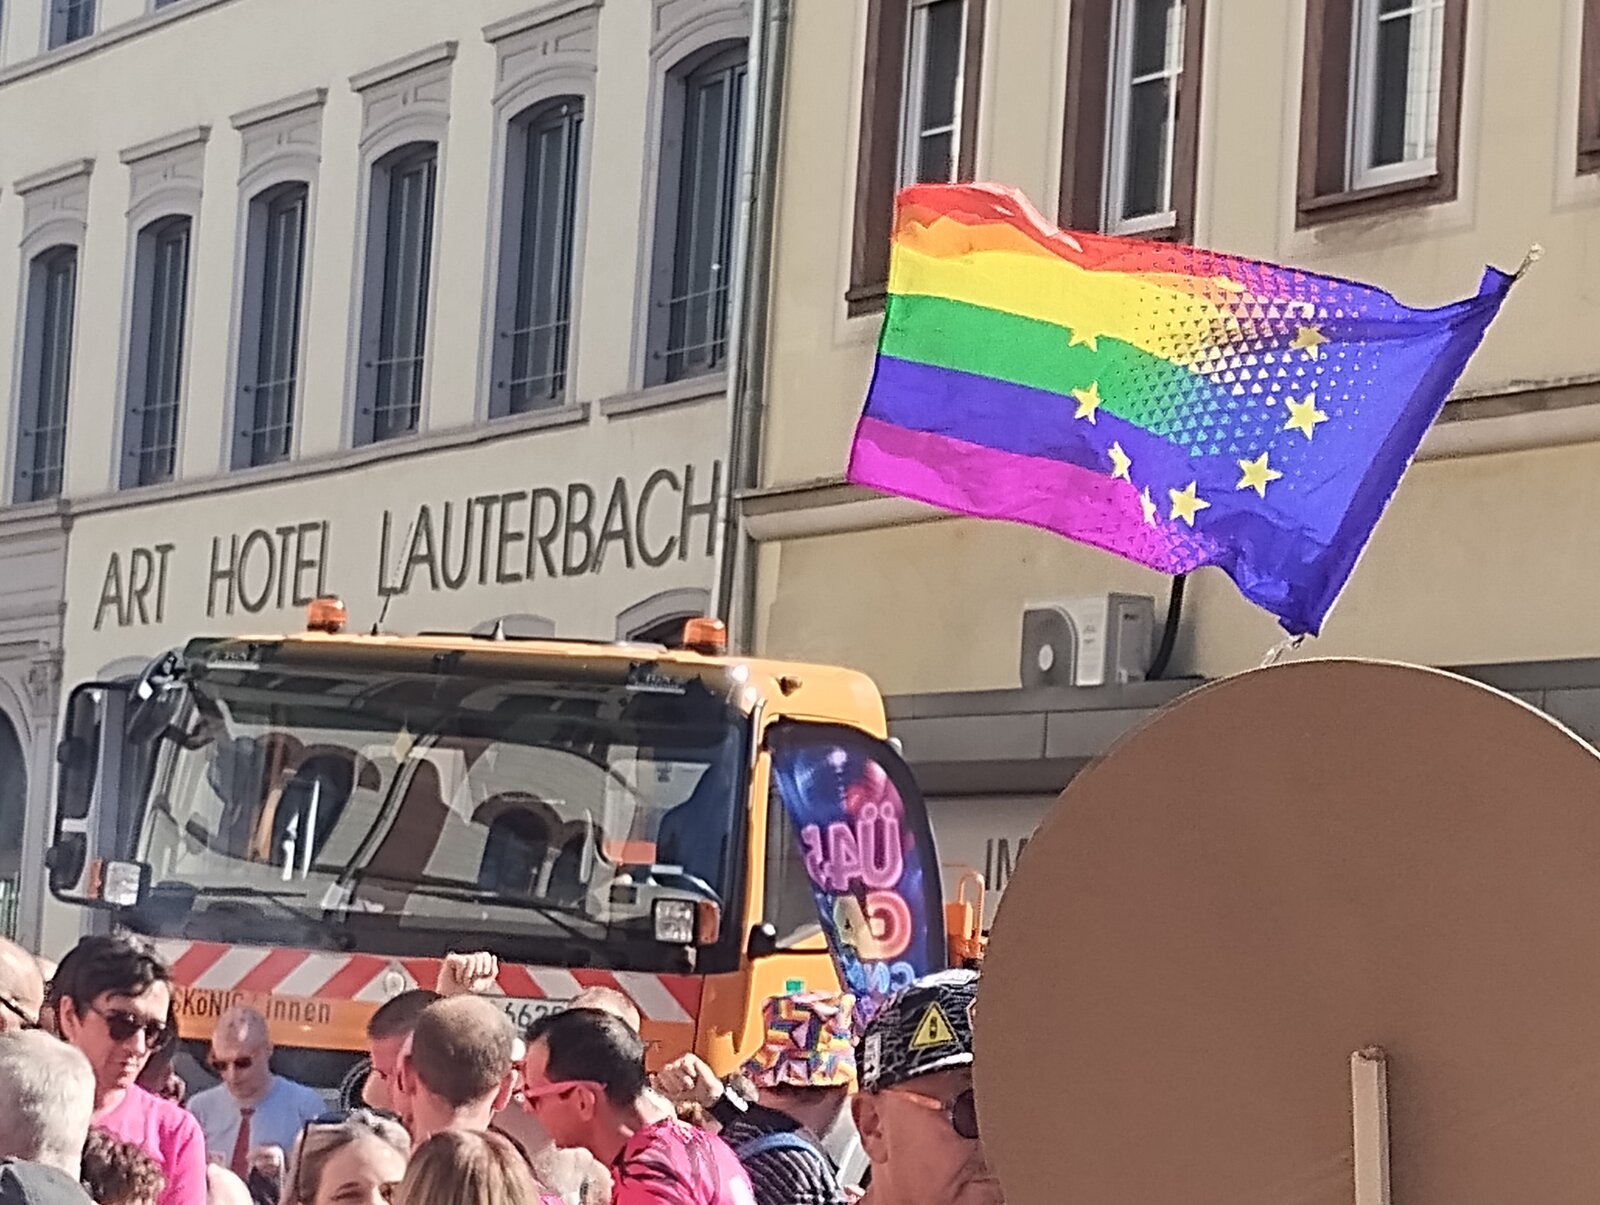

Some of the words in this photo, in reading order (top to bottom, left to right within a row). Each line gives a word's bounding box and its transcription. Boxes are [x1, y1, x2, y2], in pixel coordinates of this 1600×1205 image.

[94, 543, 176, 632] ART
[206, 519, 331, 618] HOTEL
[377, 459, 722, 597] LAUTERBACH
